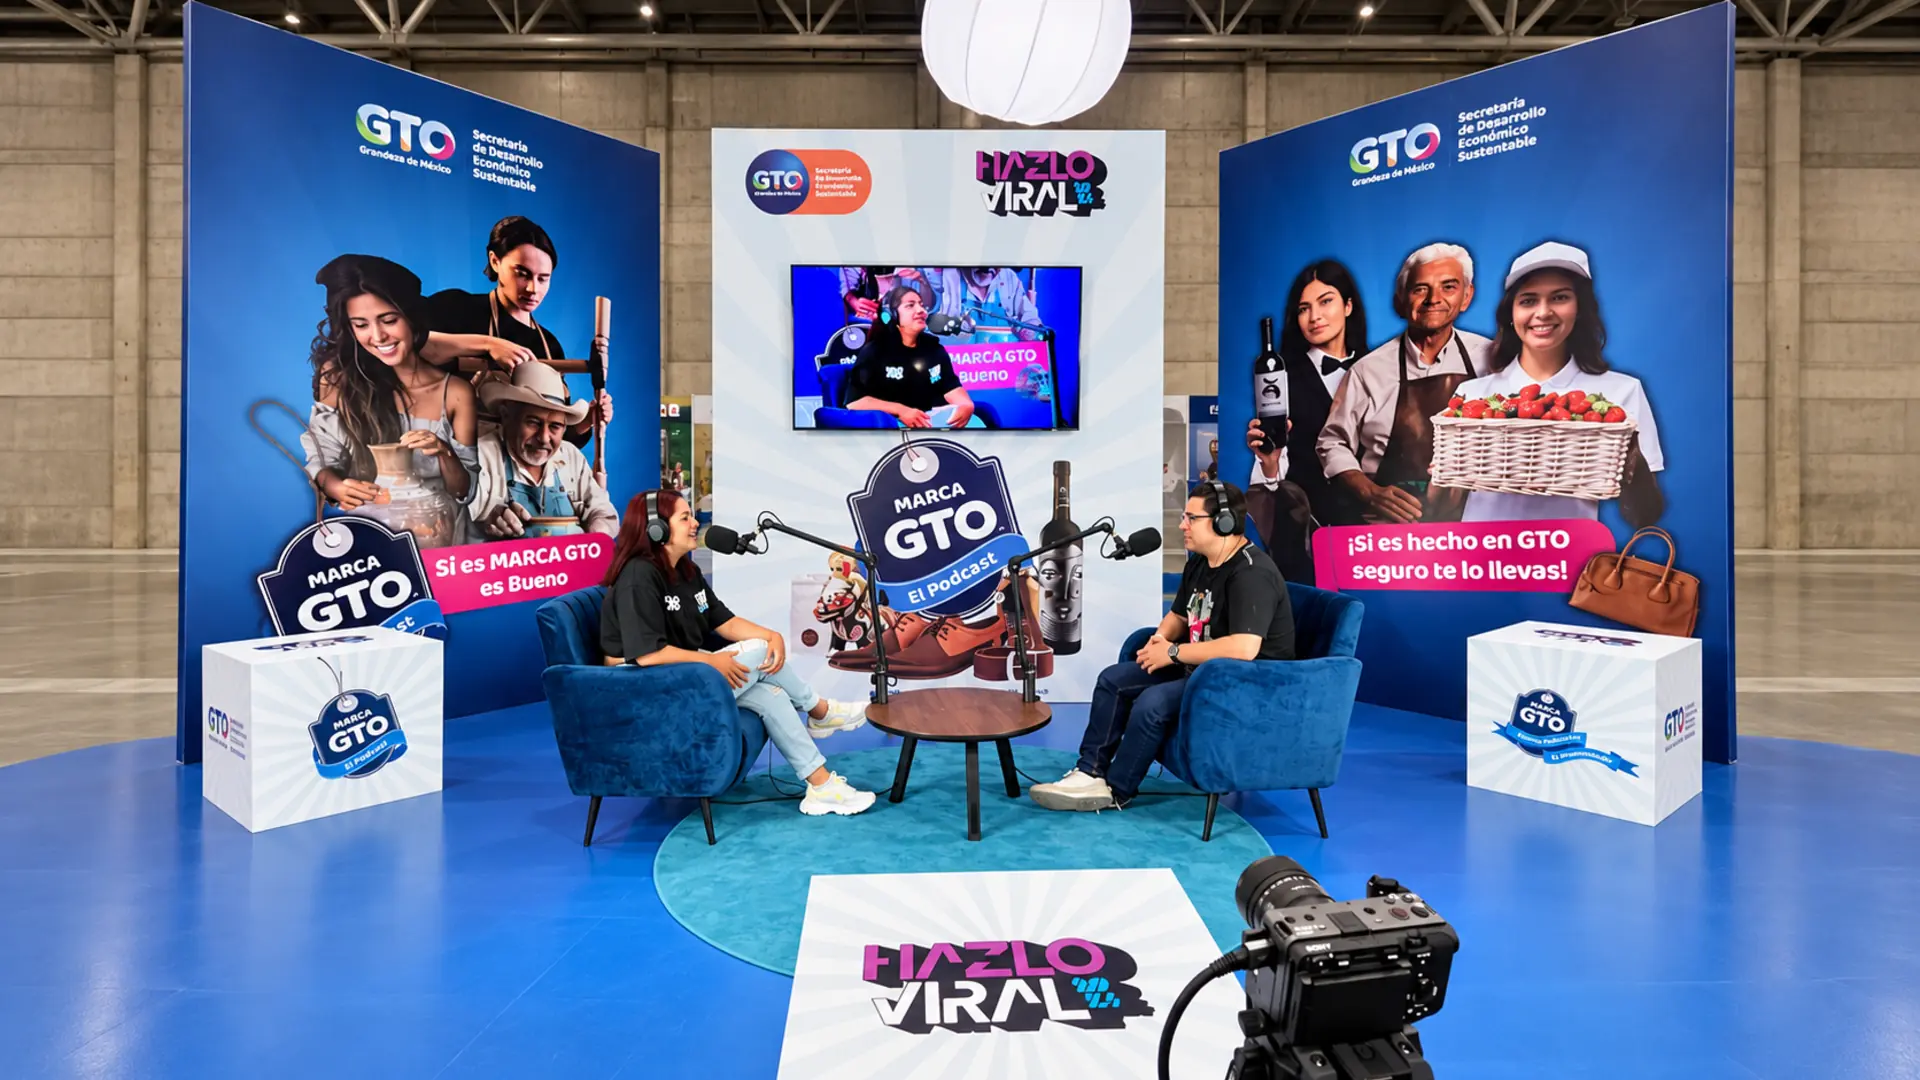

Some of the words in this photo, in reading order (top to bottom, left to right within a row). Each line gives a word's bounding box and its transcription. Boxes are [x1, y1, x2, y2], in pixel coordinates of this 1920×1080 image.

[1458, 97, 1526, 124] Secretaría
[1458, 123, 1475, 136] de
[1477, 106, 1547, 132] Desarrollo
[356, 103, 456, 160] GTO
[472, 129, 528, 153] Secretaría
[1458, 124, 1529, 149] Económico
[406, 156, 418, 167] de
[473, 142, 487, 154] de
[489, 146, 544, 169] Desarrollo
[1349, 122, 1441, 174] GTO
[1457, 135, 1537, 162] Sustentable
[473, 155, 531, 179] Económico
[976, 150, 1095, 180] HAZLO
[1391, 167, 1403, 178] de
[473, 168, 537, 192] Sustentable
[752, 170, 803, 190] GTO
[980, 181, 1078, 211] VIRAL
[950, 350, 1003, 365] MARCA
[1005, 349, 1037, 363] GTO
[894, 482, 966, 514] MARCA
[884, 500, 998, 560] GTO
[1348, 533, 1373, 556] ¡Si
[1378, 536, 1403, 551] es
[1407, 531, 1478, 551] hecho
[1482, 533, 1512, 549] en
[1517, 530, 1570, 549] GTO
[307, 555, 382, 589] MARCA
[435, 555, 456, 577] Si
[460, 558, 485, 573] es
[490, 547, 562, 571] MARCA
[564, 542, 601, 561] GTO
[1352, 563, 1428, 584] seguro
[1433, 562, 1457, 580] te
[1461, 560, 1484, 580] lo
[1489, 560, 1568, 580] llevas!
[480, 581, 504, 597] es
[508, 573, 568, 593] Bueno
[907, 588, 926, 604] El
[927, 551, 998, 597] Podcast
[297, 570, 412, 632] GTO
[333, 708, 373, 730] MARCA
[1519, 707, 1566, 733] GTO
[1530, 700, 1561, 716] MARCA
[208, 706, 229, 739] GTO
[328, 715, 389, 753] GTO
[1664, 706, 1685, 741] GTO
[862, 937, 1106, 980] HAZLO
[871, 978, 1092, 1025] VIRAL
